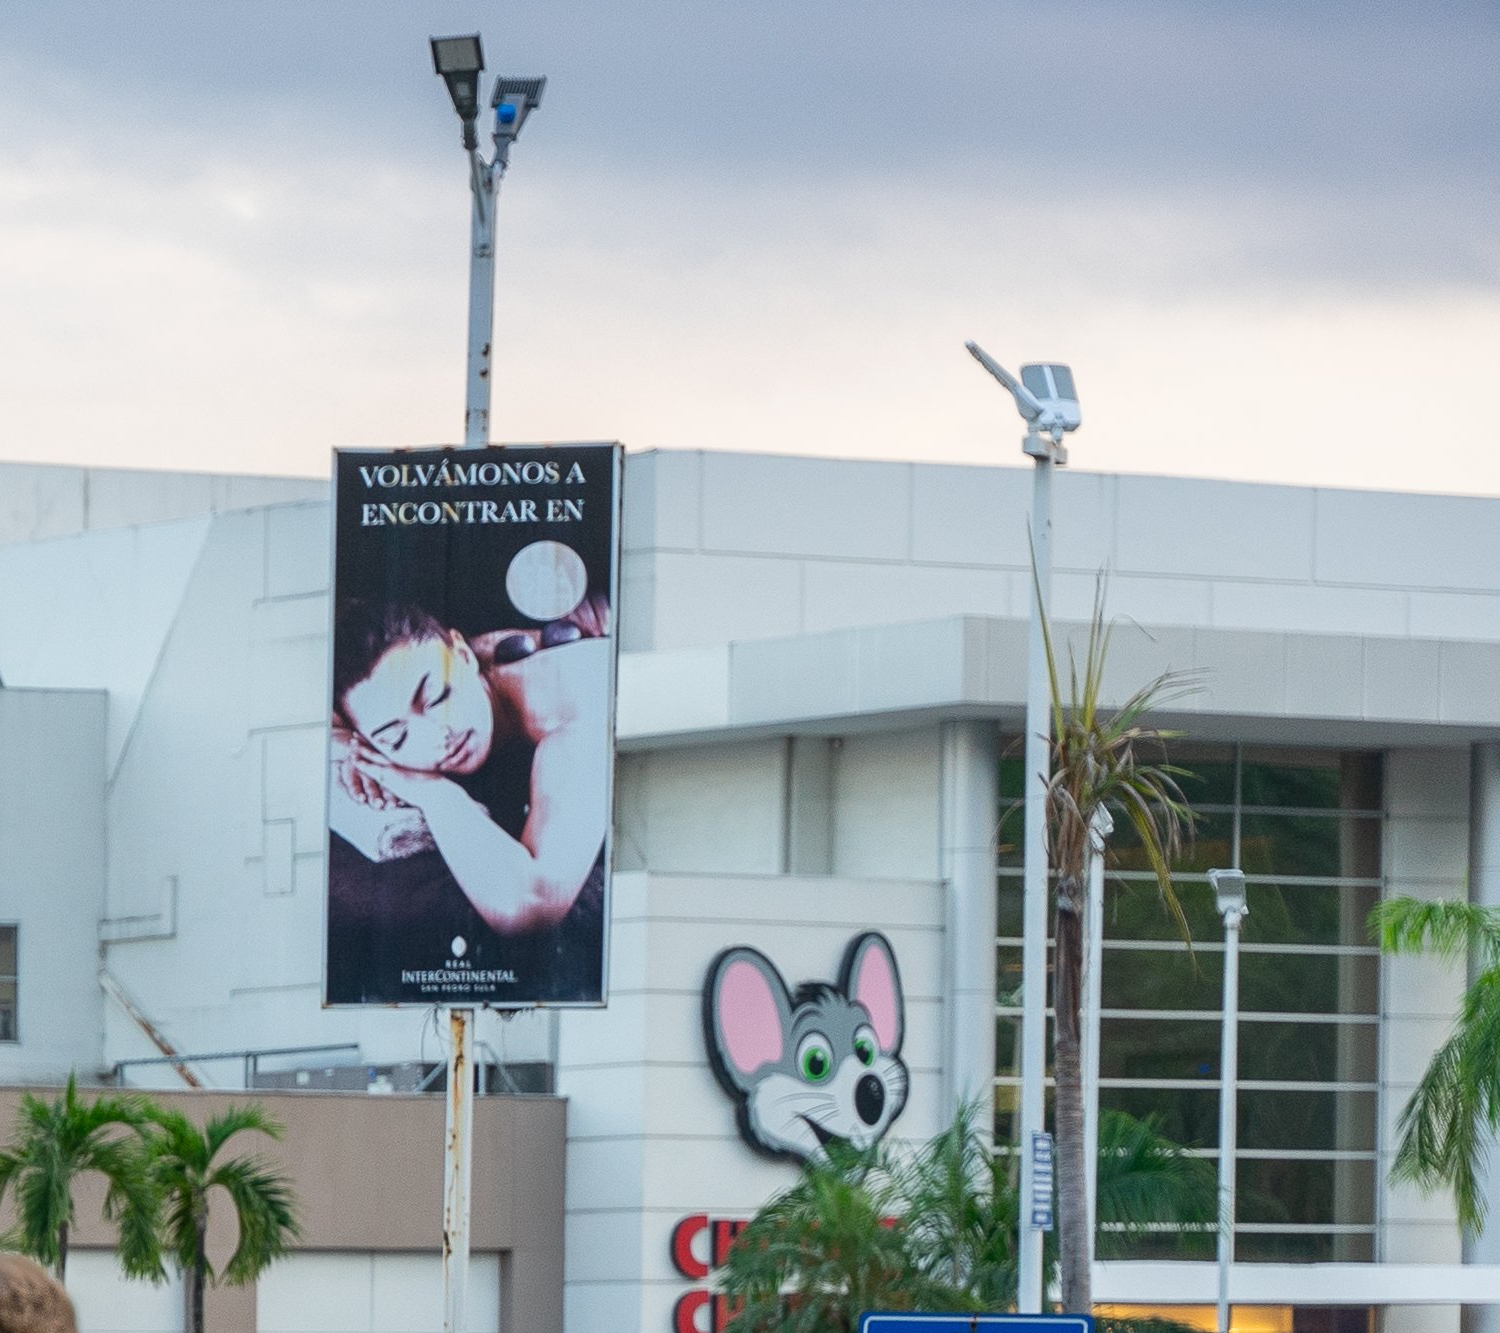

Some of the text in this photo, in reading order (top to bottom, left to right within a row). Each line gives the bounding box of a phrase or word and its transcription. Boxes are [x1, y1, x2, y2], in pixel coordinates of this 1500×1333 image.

[358, 458, 587, 488] VOLVÁMONOS A
[361, 499, 585, 526] ENCONTRAR EN
[445, 960, 472, 969] REAL
[421, 984, 496, 992] SAN PEDRO SULA
